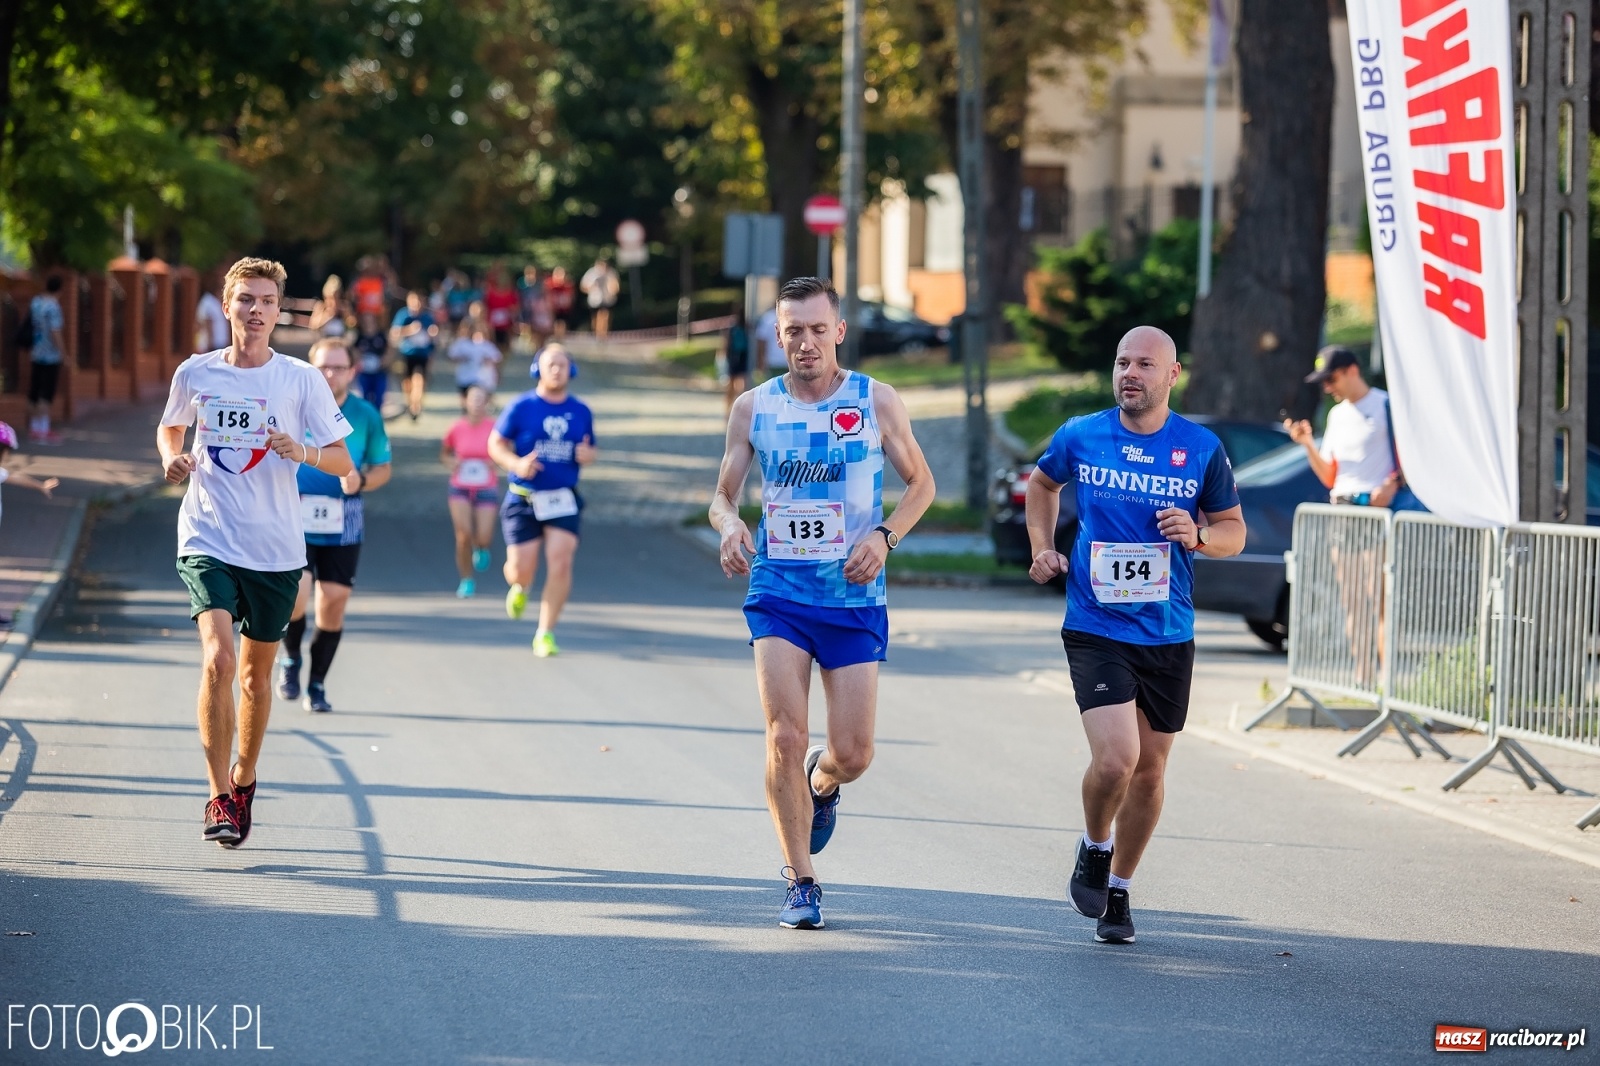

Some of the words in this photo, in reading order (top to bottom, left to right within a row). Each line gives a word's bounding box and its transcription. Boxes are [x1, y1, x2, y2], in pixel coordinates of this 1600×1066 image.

[217, 410, 250, 428] 158
[1078, 463, 1198, 498] RUNNERS
[1148, 498, 1175, 508] TEAM
[788, 520, 825, 539] 133
[1111, 560, 1151, 580] 154
